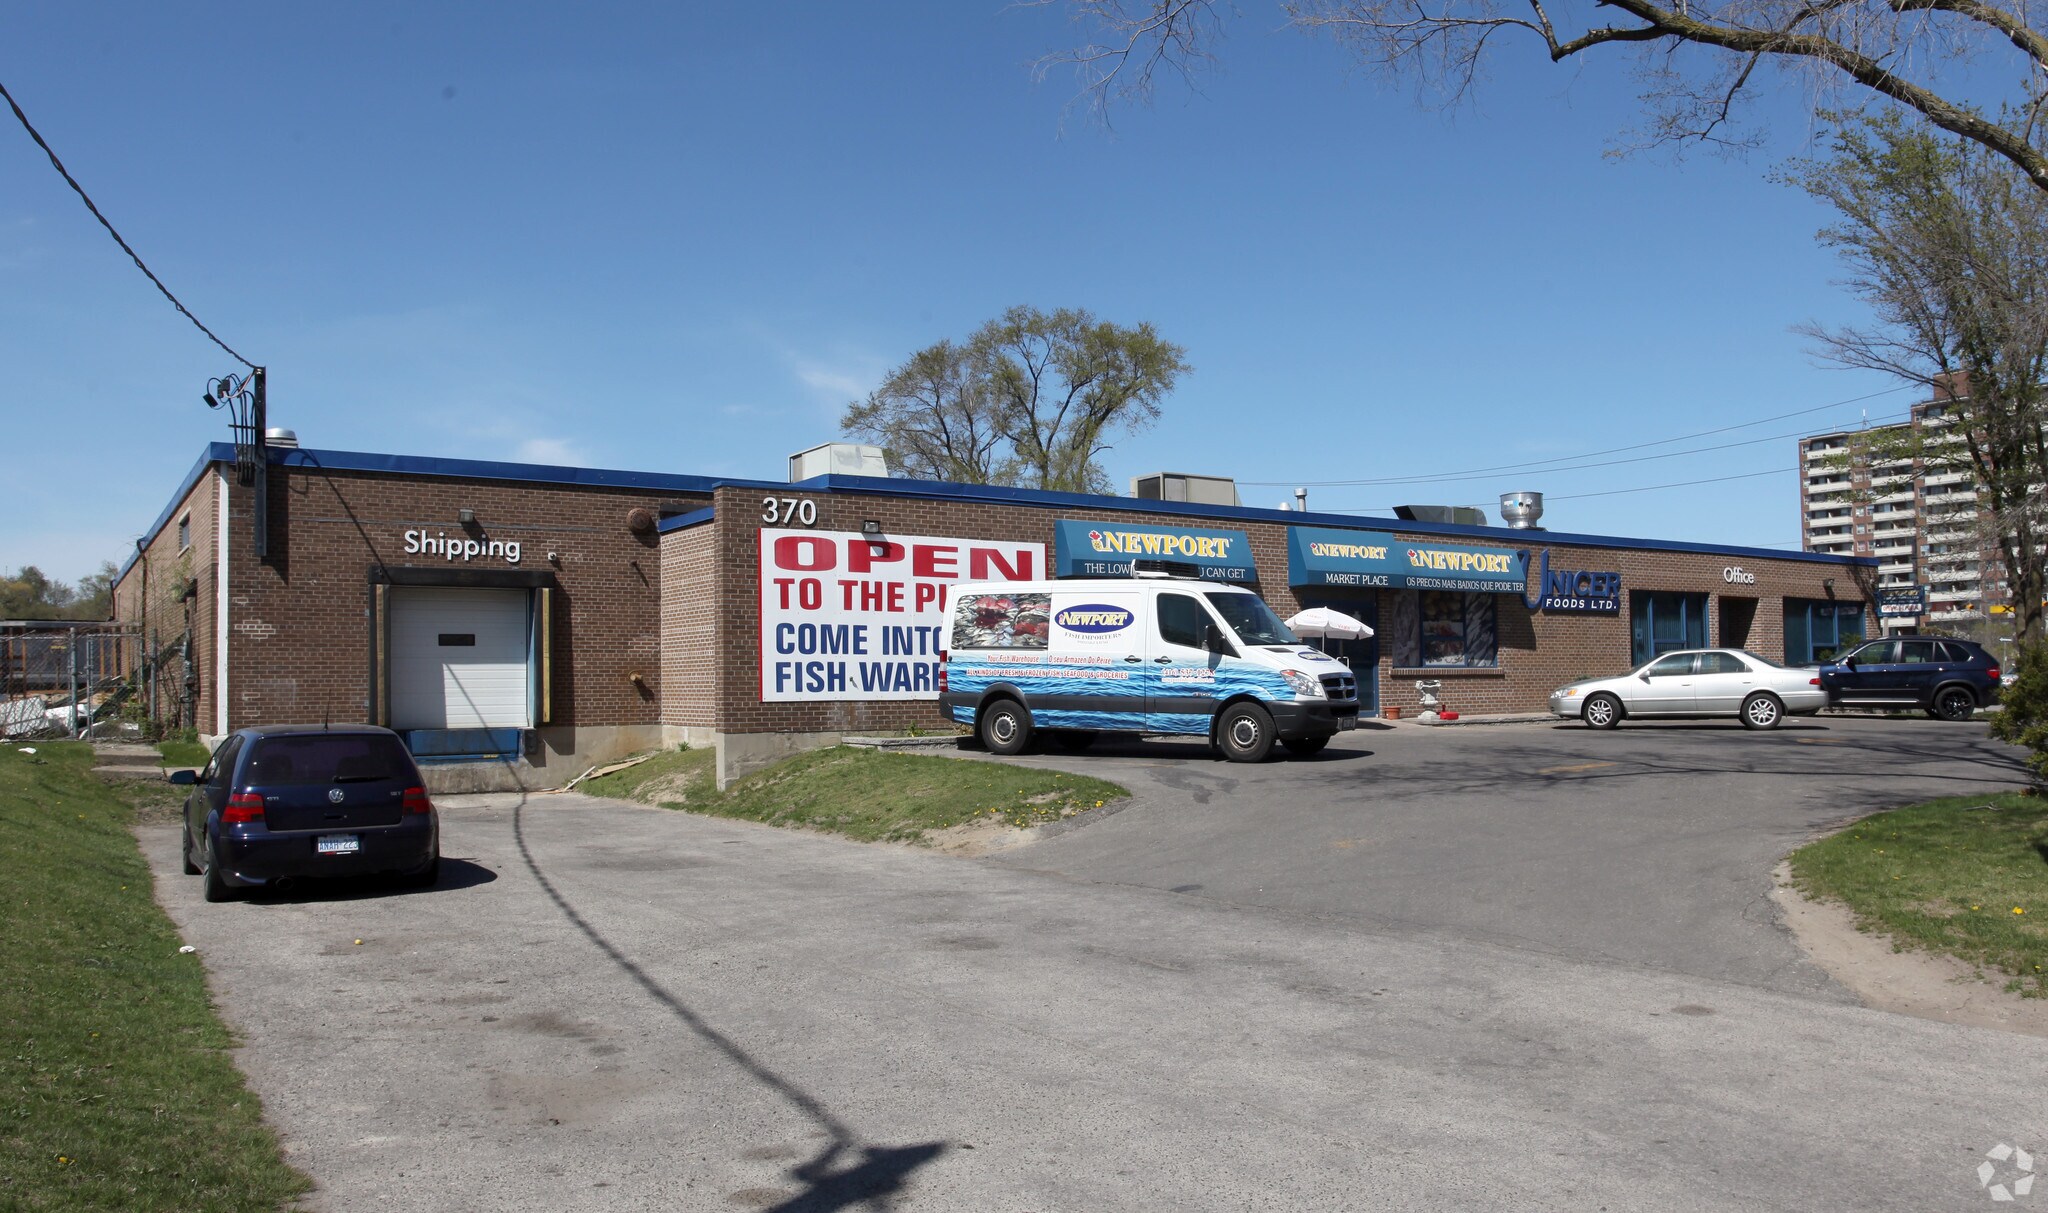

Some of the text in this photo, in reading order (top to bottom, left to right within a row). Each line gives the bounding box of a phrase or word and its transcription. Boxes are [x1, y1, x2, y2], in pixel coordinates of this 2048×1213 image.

[762, 496, 817, 525] 370
[404, 530, 520, 562] Shipping
[1102, 531, 1231, 559] NEWPORT
[1316, 543, 1387, 560] NEWPORT
[774, 536, 1033, 581] OPEN
[1416, 549, 1513, 573] NEWPORT
[1084, 563, 1106, 574] THE
[1206, 567, 1226, 578] CAN
[1227, 568, 1246, 579] GET
[1325, 573, 1389, 586] MARKET PLACE
[1517, 548, 1621, 609] UNICER
[1723, 566, 1755, 584] Office
[773, 578, 822, 610] TO
[837, 580, 905, 612] THE
[1406, 577, 1416, 587] OS
[1441, 579, 1457, 589] MAIS
[1457, 580, 1480, 590] BAIXOS
[1480, 581, 1494, 592] QUE
[1494, 582, 1512, 591] PODE
[1512, 582, 1525, 591] TER
[1545, 598, 1617, 609] FOODS LTD.
[1061, 611, 1129, 626] NEWPORT
[776, 623, 868, 655] COME
[1011, 655, 1040, 663] Warehouse
[775, 661, 846, 693] FISH
